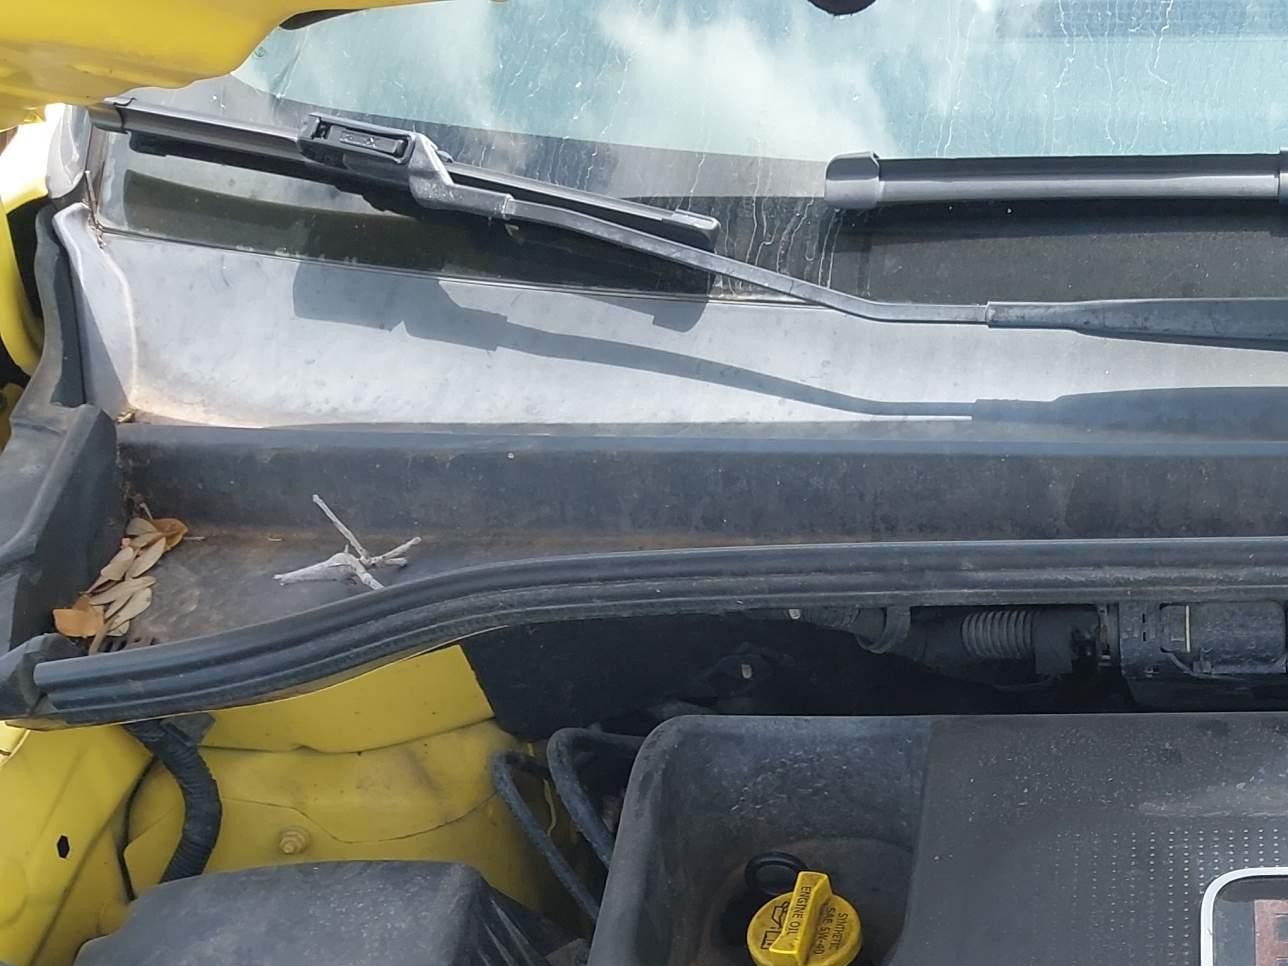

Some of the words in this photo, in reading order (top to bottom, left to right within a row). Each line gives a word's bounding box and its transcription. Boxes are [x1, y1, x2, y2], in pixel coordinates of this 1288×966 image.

[791, 885, 812, 919] ENGINE
[787, 921, 801, 935] OIL
[822, 907, 836, 924] SAE
[828, 912, 849, 951] SYNTHETIC
